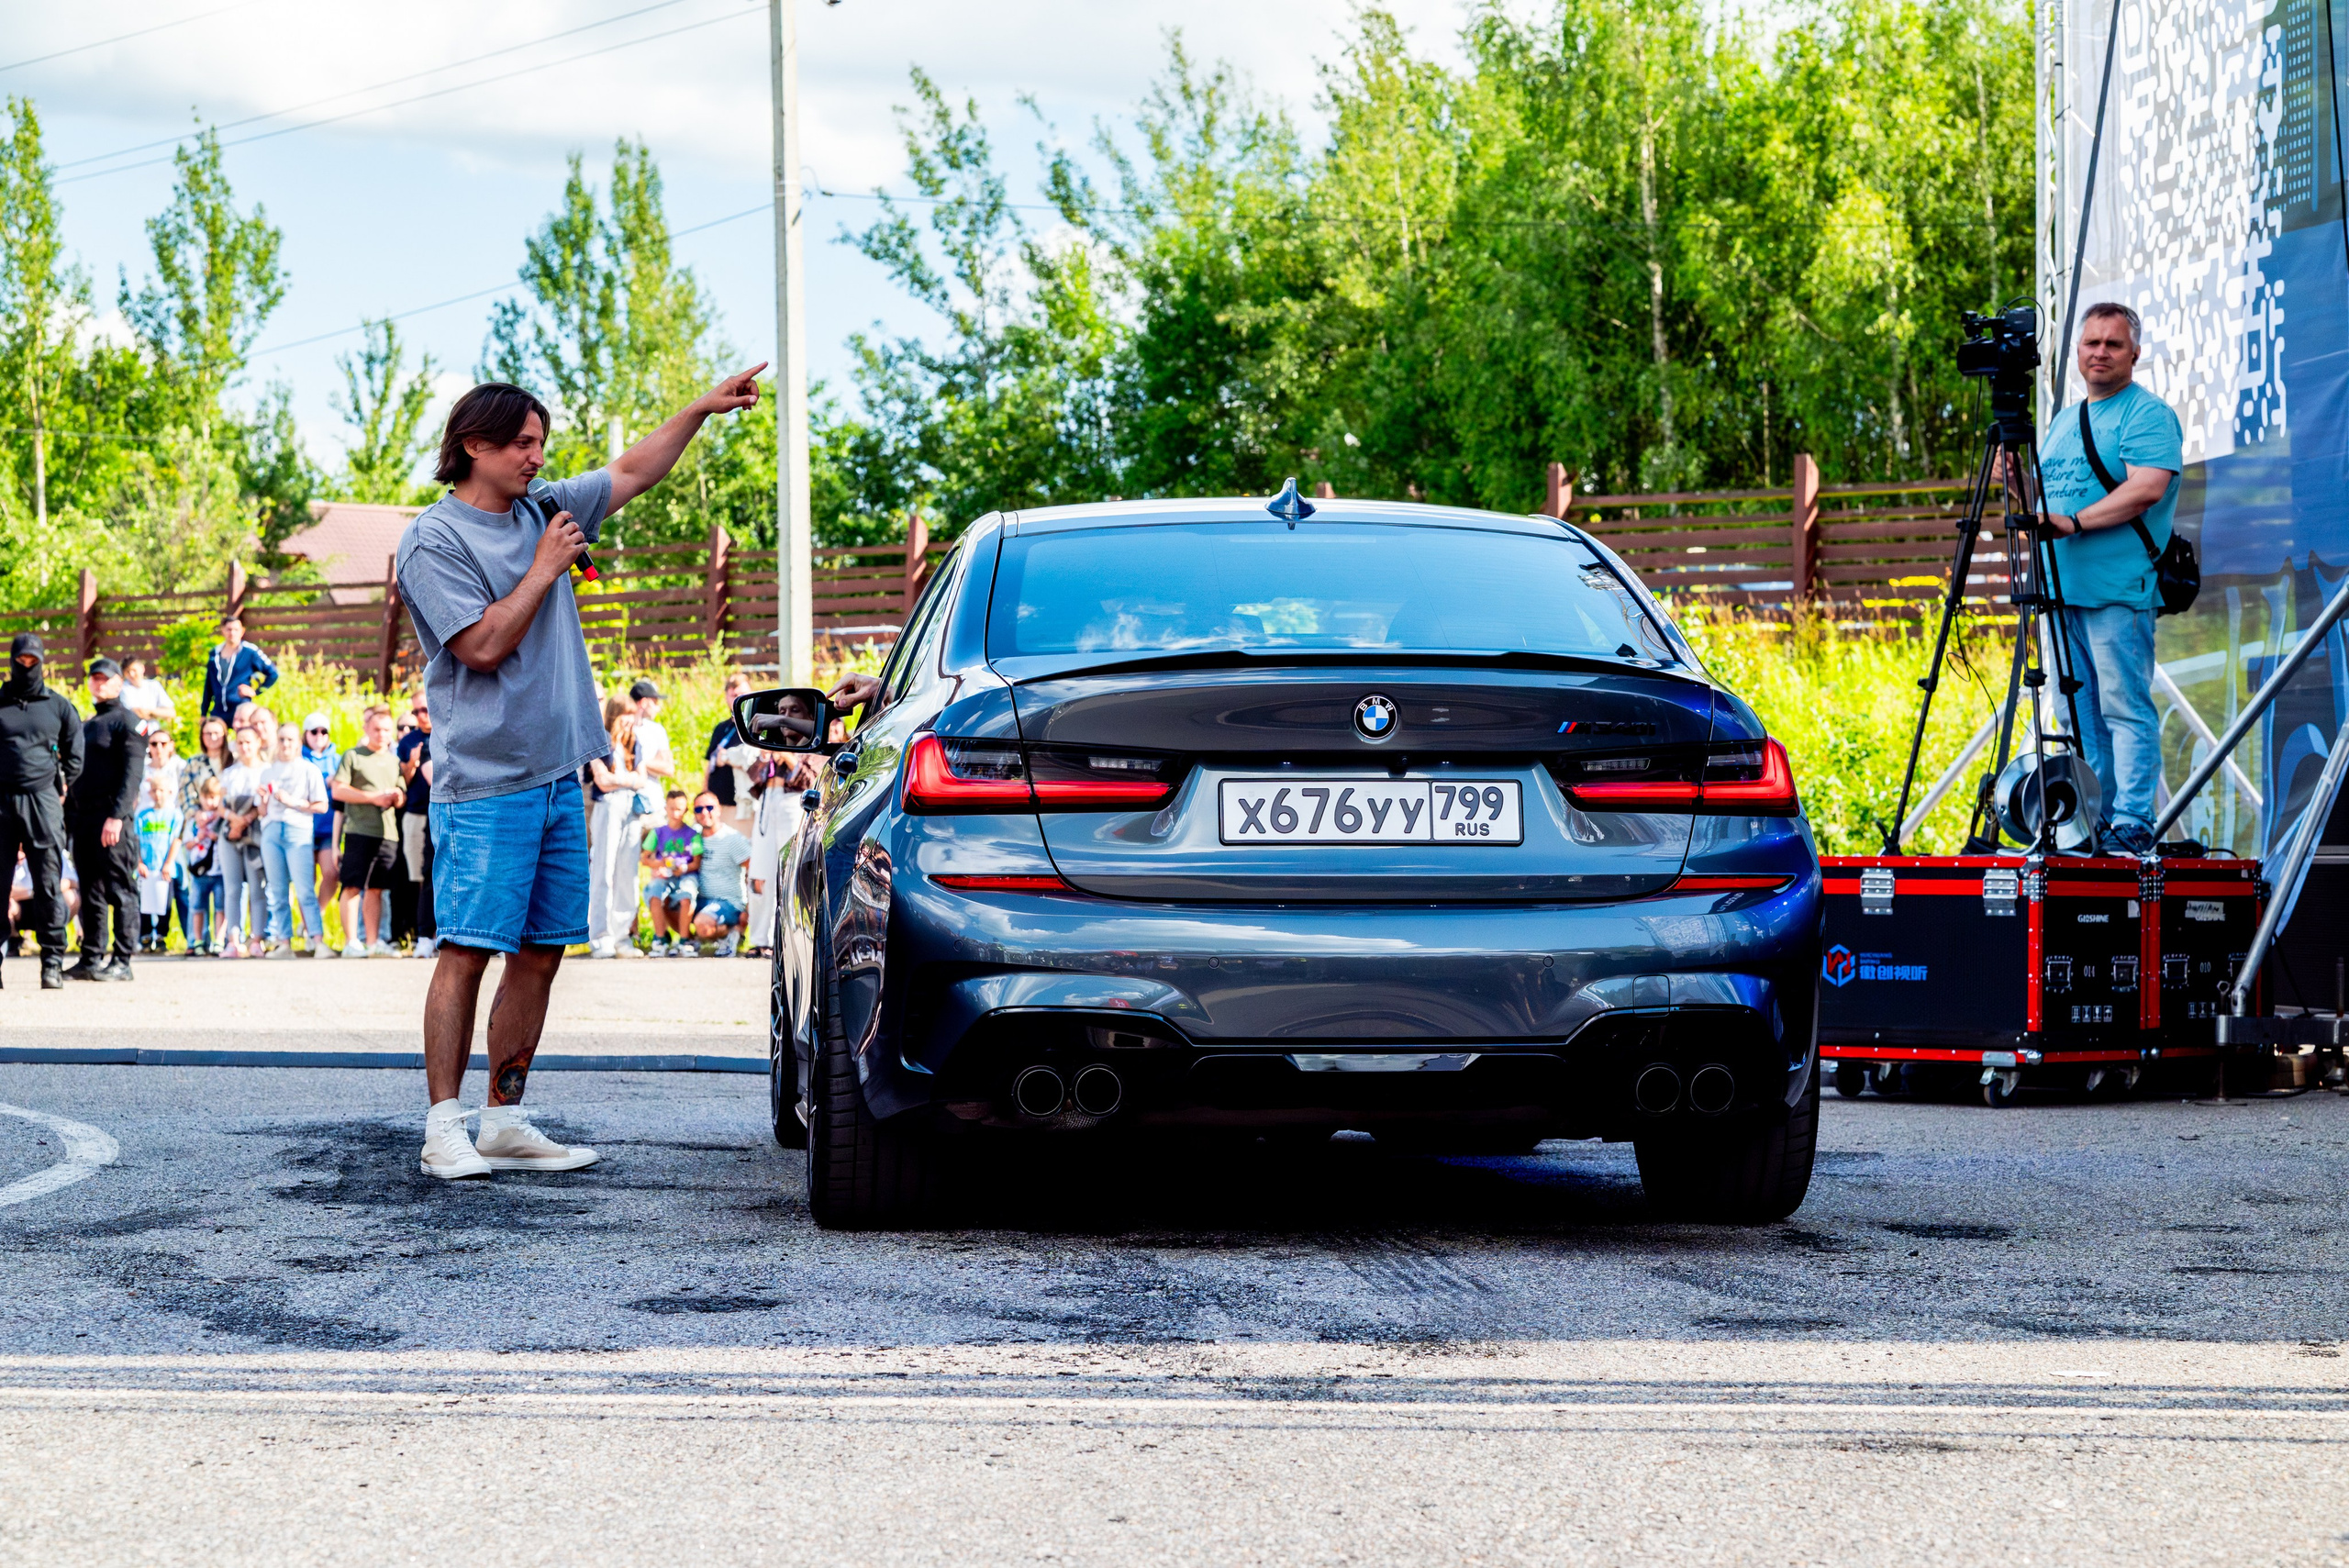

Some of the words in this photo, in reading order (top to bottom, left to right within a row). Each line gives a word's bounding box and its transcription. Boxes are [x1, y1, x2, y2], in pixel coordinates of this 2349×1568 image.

[1359, 697, 1394, 712] BMW
[1434, 785, 1504, 820] 799
[1454, 822, 1490, 836] RUS
